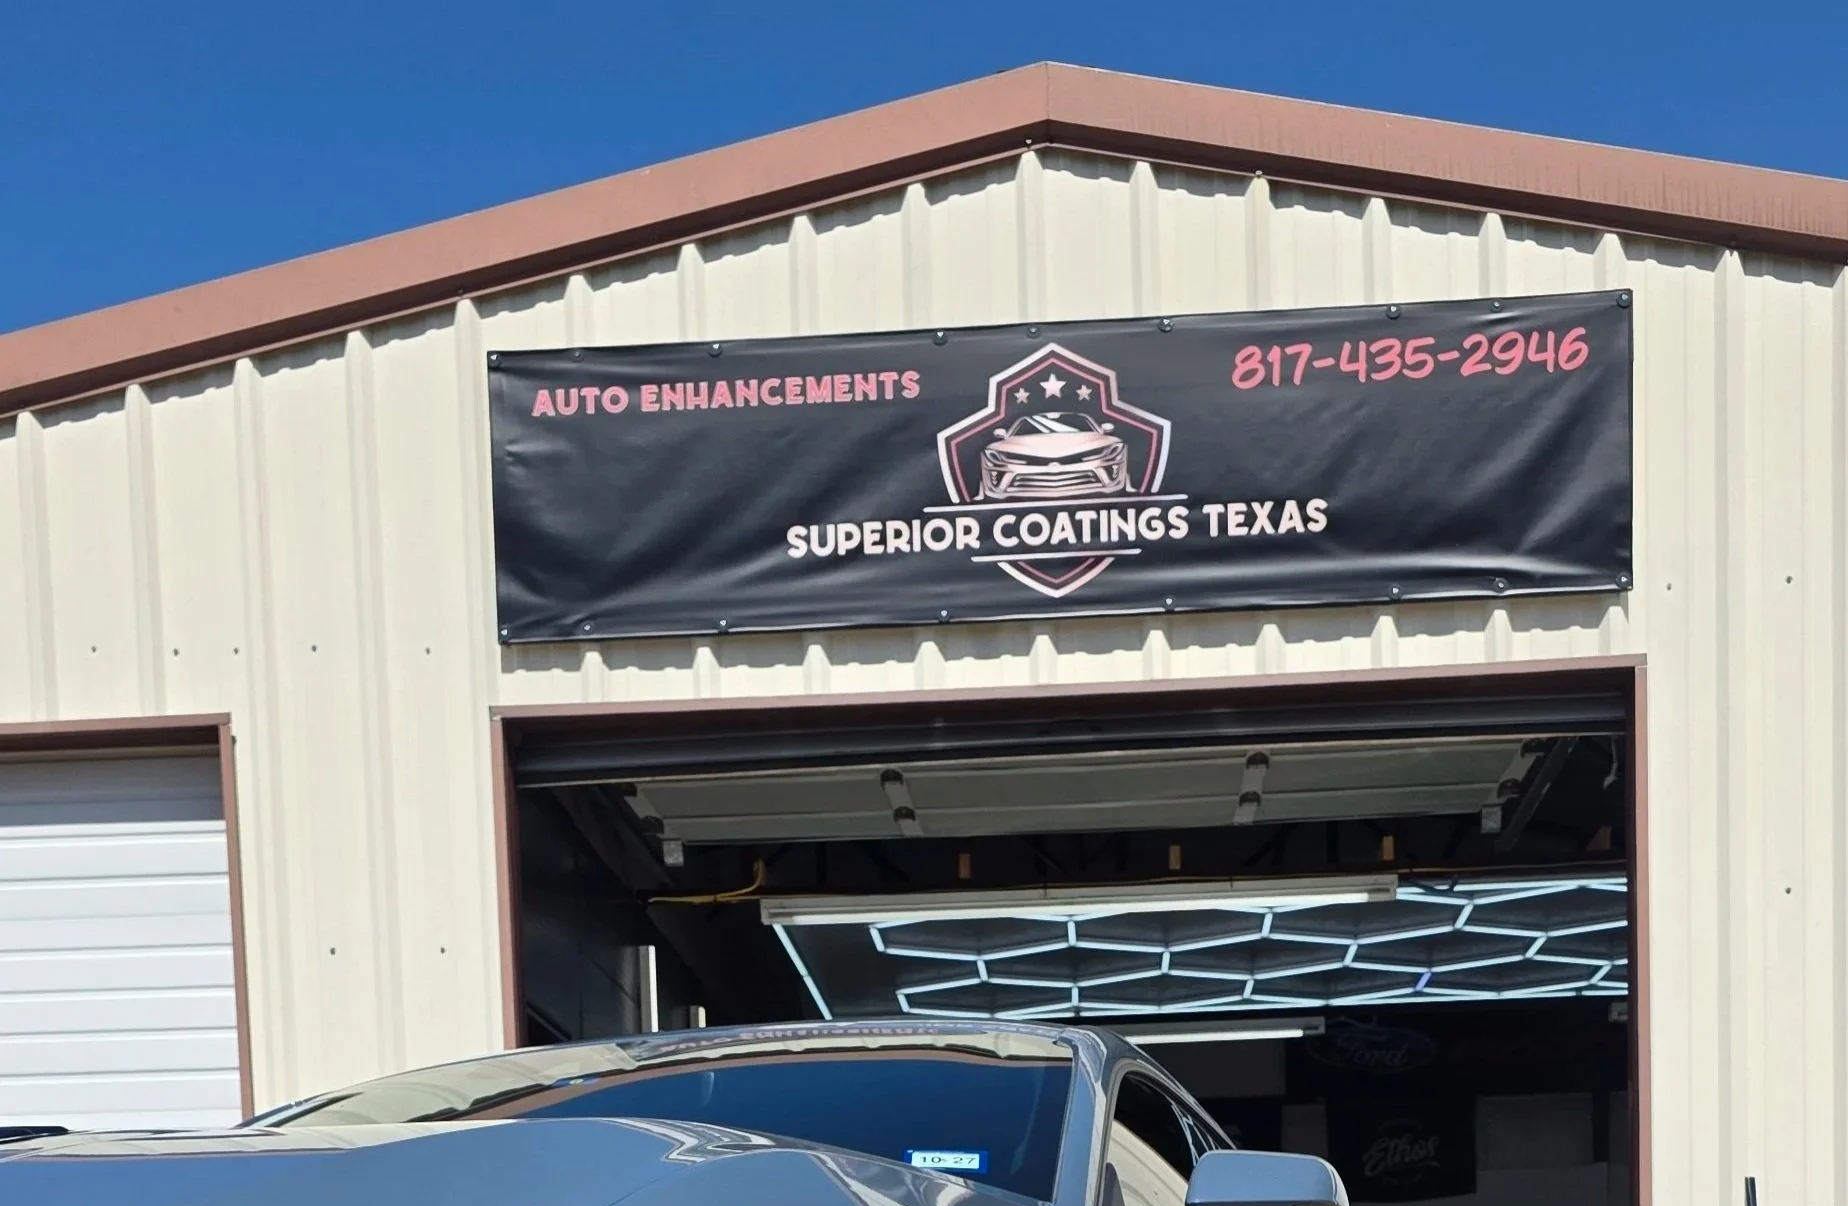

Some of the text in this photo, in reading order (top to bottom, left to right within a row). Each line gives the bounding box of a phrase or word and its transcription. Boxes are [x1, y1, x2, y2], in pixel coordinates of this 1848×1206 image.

[1231, 326, 1590, 390] 817-435-2946
[531, 370, 921, 417] AUTO ENHANCEMENTS
[786, 497, 1329, 559] SUPERIOR COATINGS TEXAS
